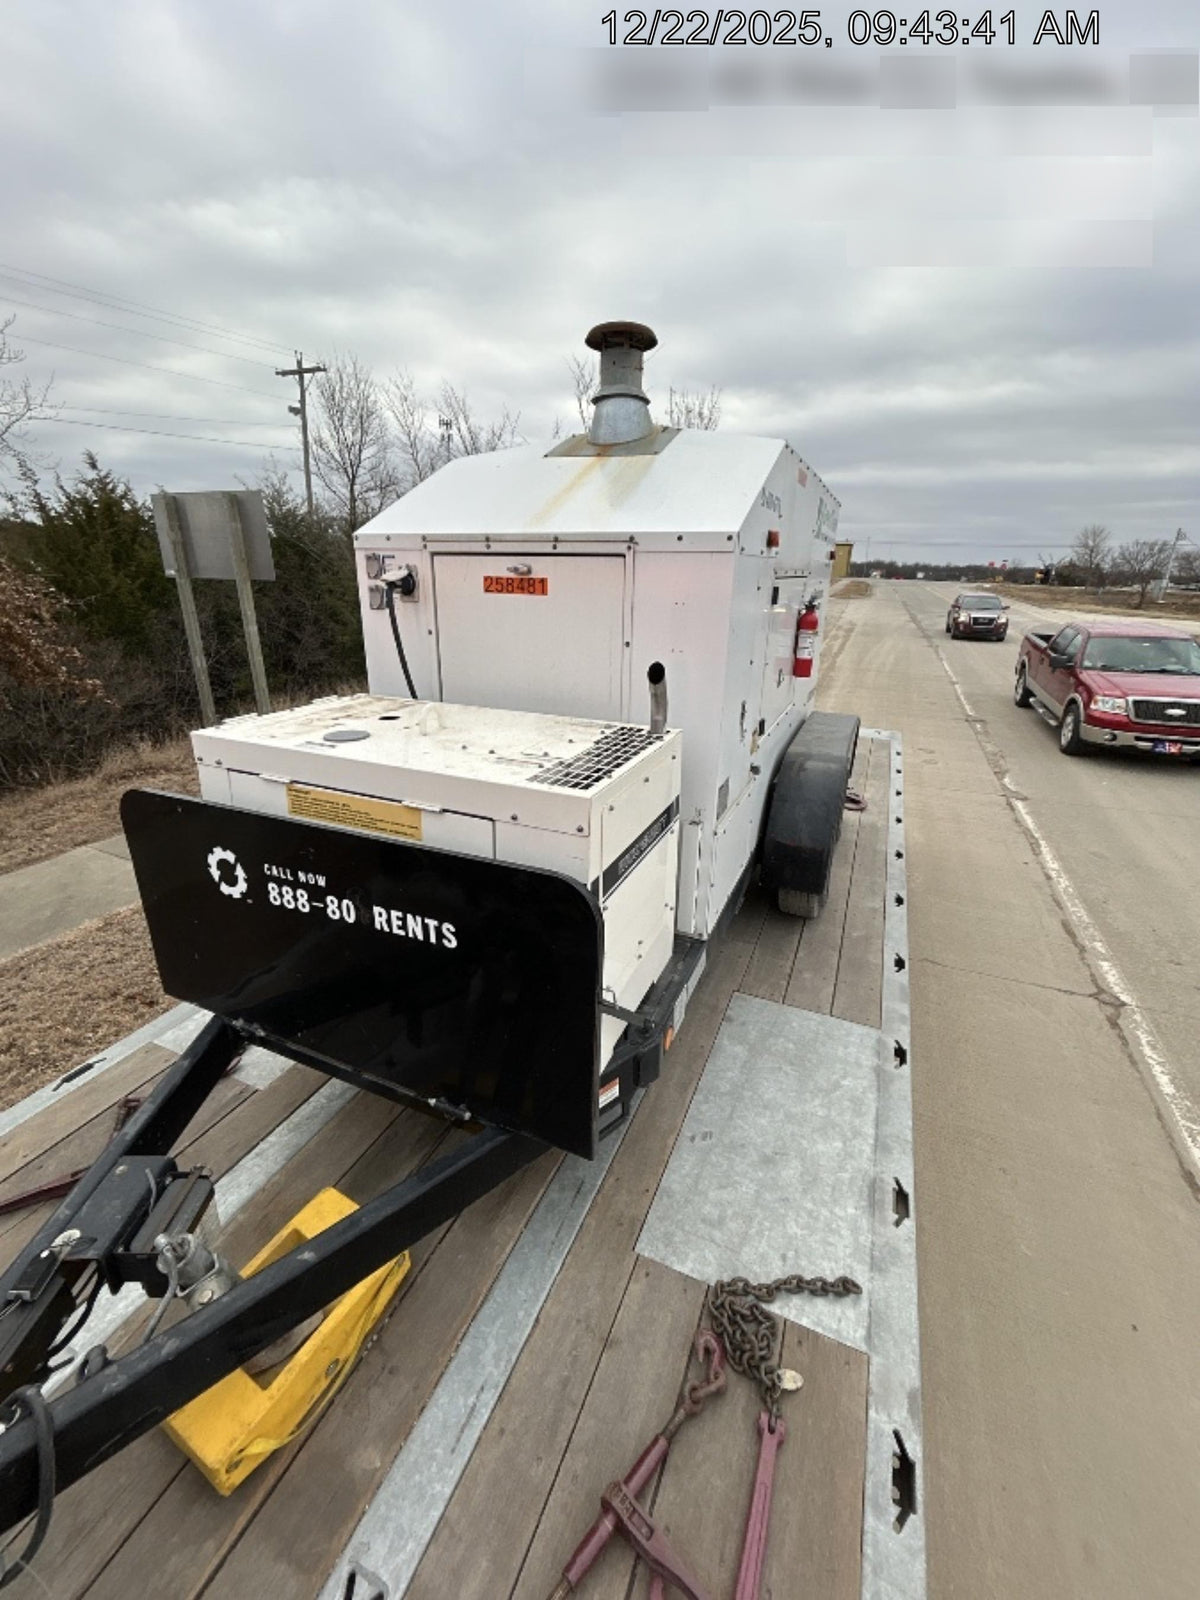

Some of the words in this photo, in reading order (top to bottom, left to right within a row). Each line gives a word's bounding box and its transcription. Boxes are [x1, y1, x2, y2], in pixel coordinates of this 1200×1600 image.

[484, 576, 546, 595] 258481
[264, 863, 294, 881] CALL
[298, 870, 326, 888] NOW
[267, 882, 356, 924] 888-80
[373, 905, 458, 949] RENTS
